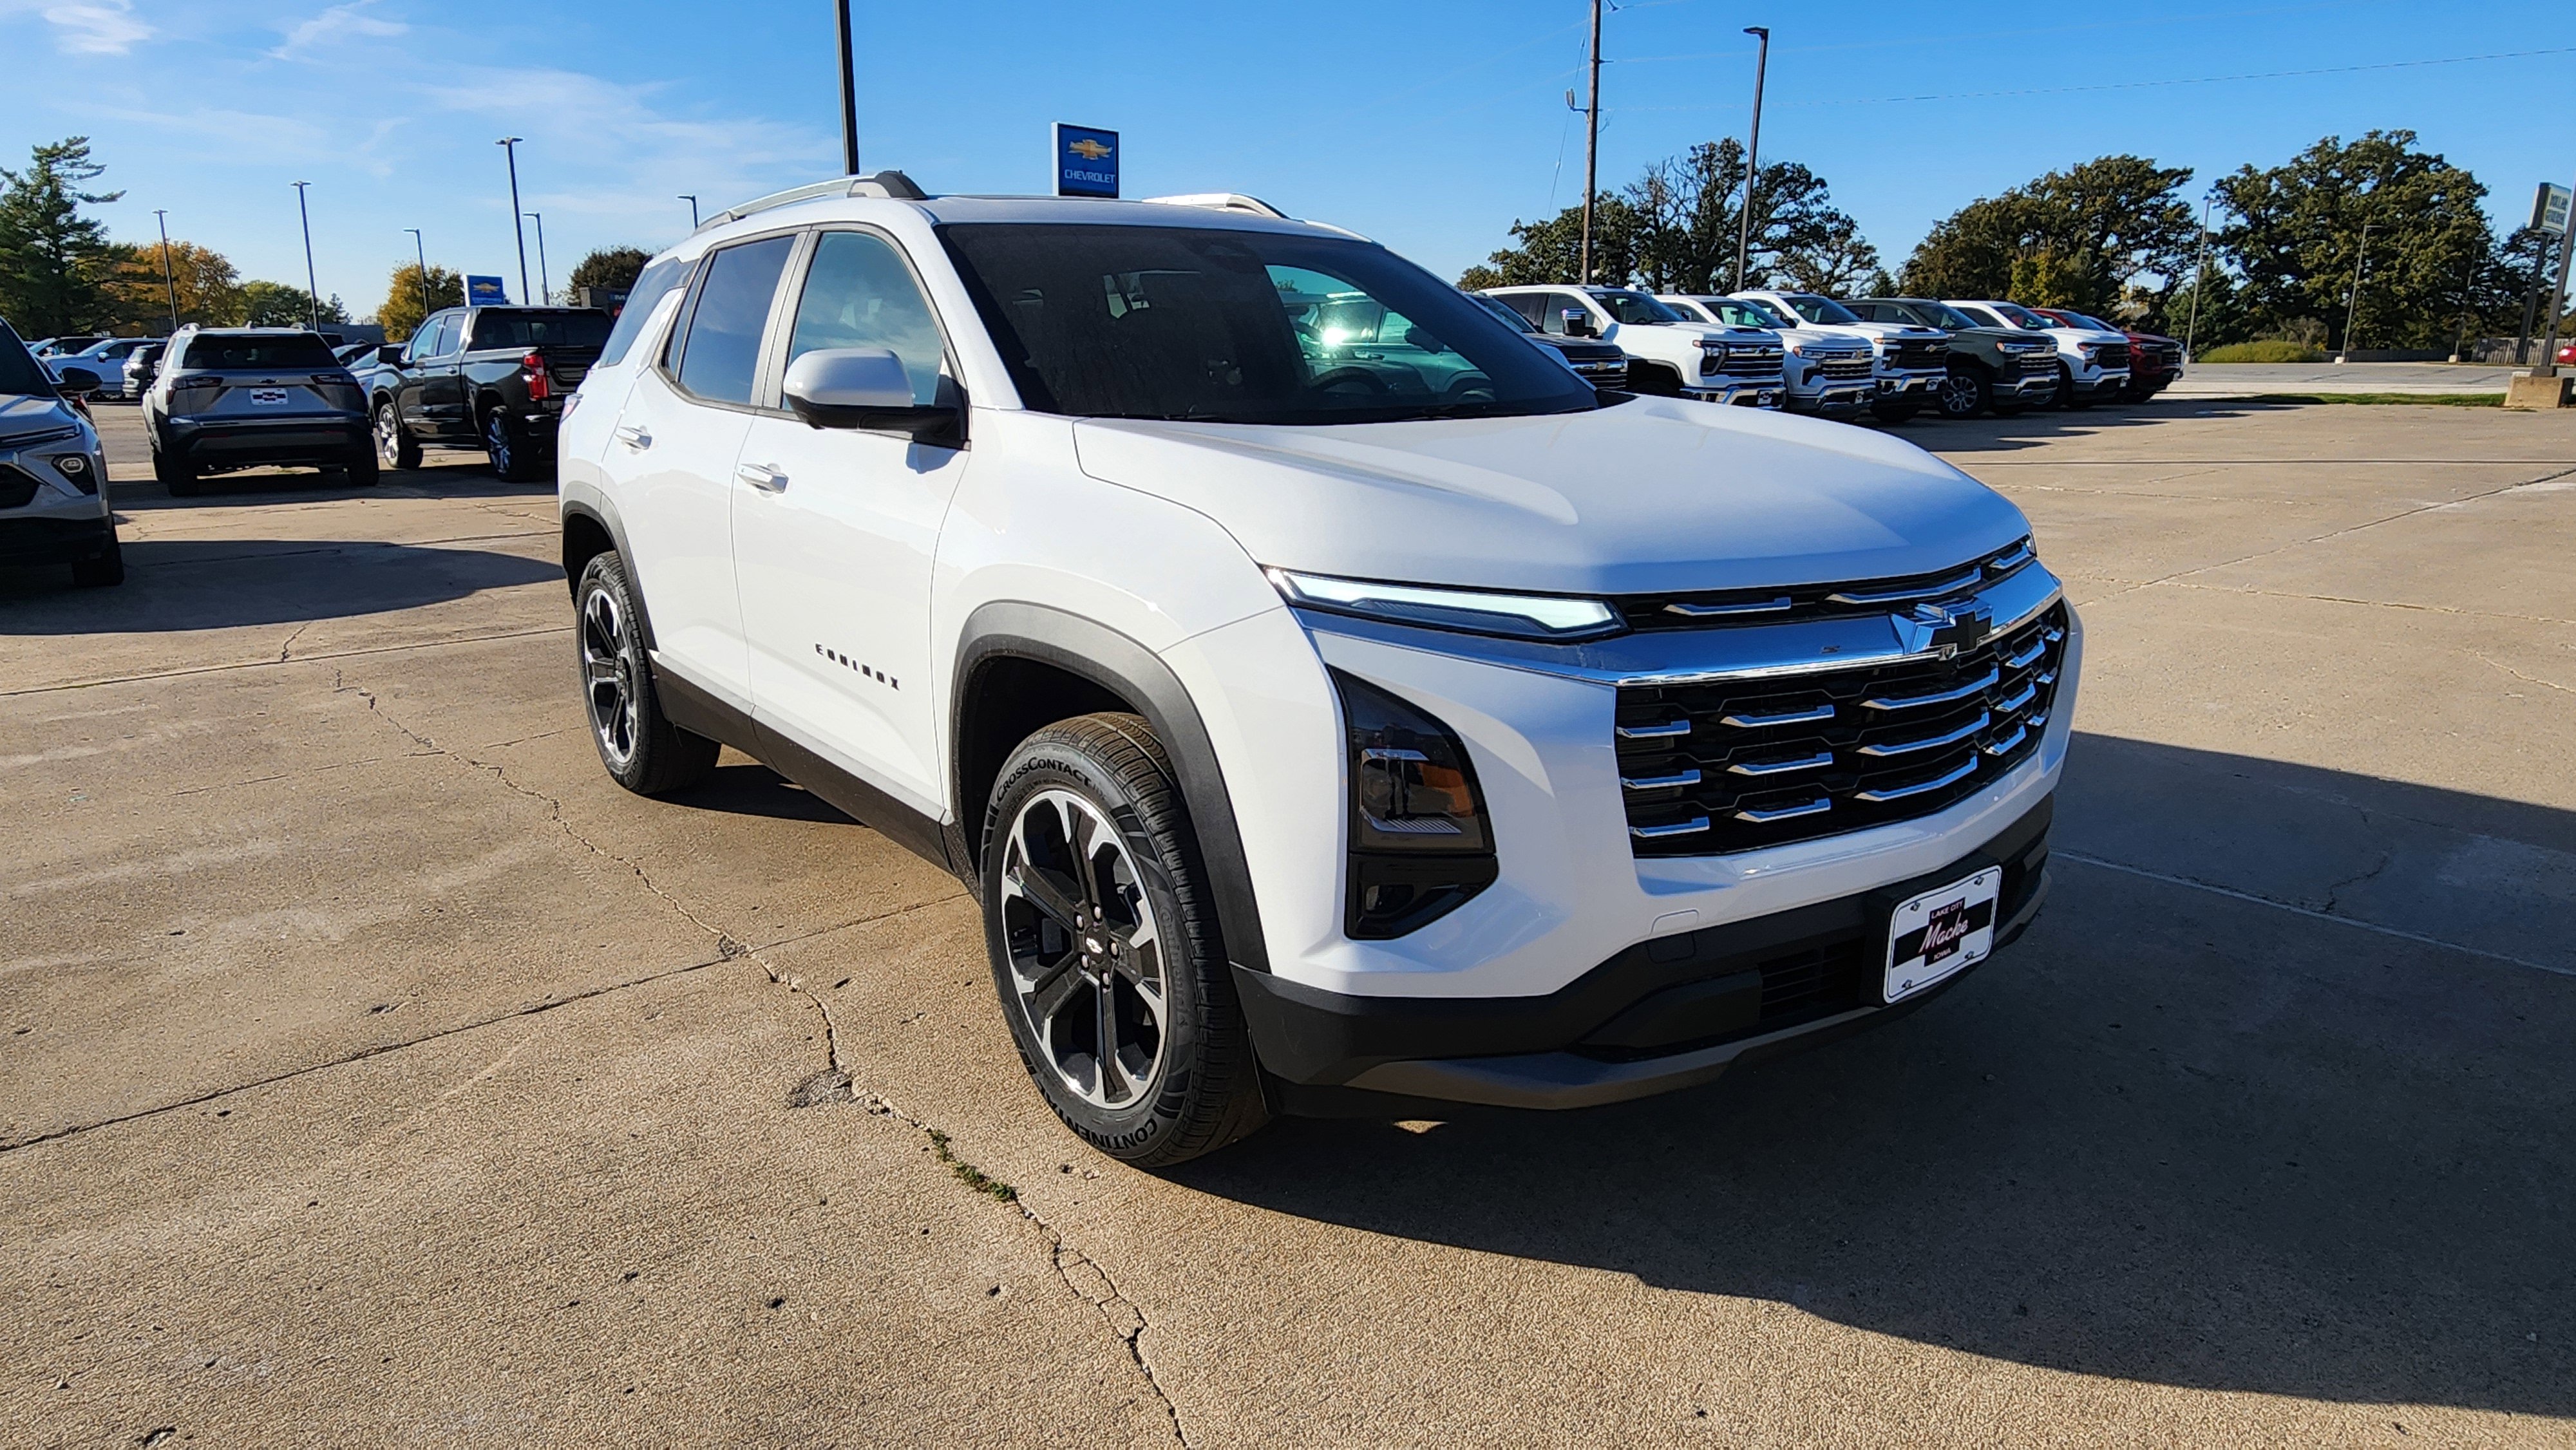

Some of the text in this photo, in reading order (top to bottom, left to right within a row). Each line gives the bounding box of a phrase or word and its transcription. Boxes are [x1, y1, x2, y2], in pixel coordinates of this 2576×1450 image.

[1064, 169, 1115, 184] CHEVROLET
[815, 643, 900, 692] EQUINOX
[1931, 900, 1964, 919] LAKE CITY
[1933, 947, 1952, 961] IOWA
